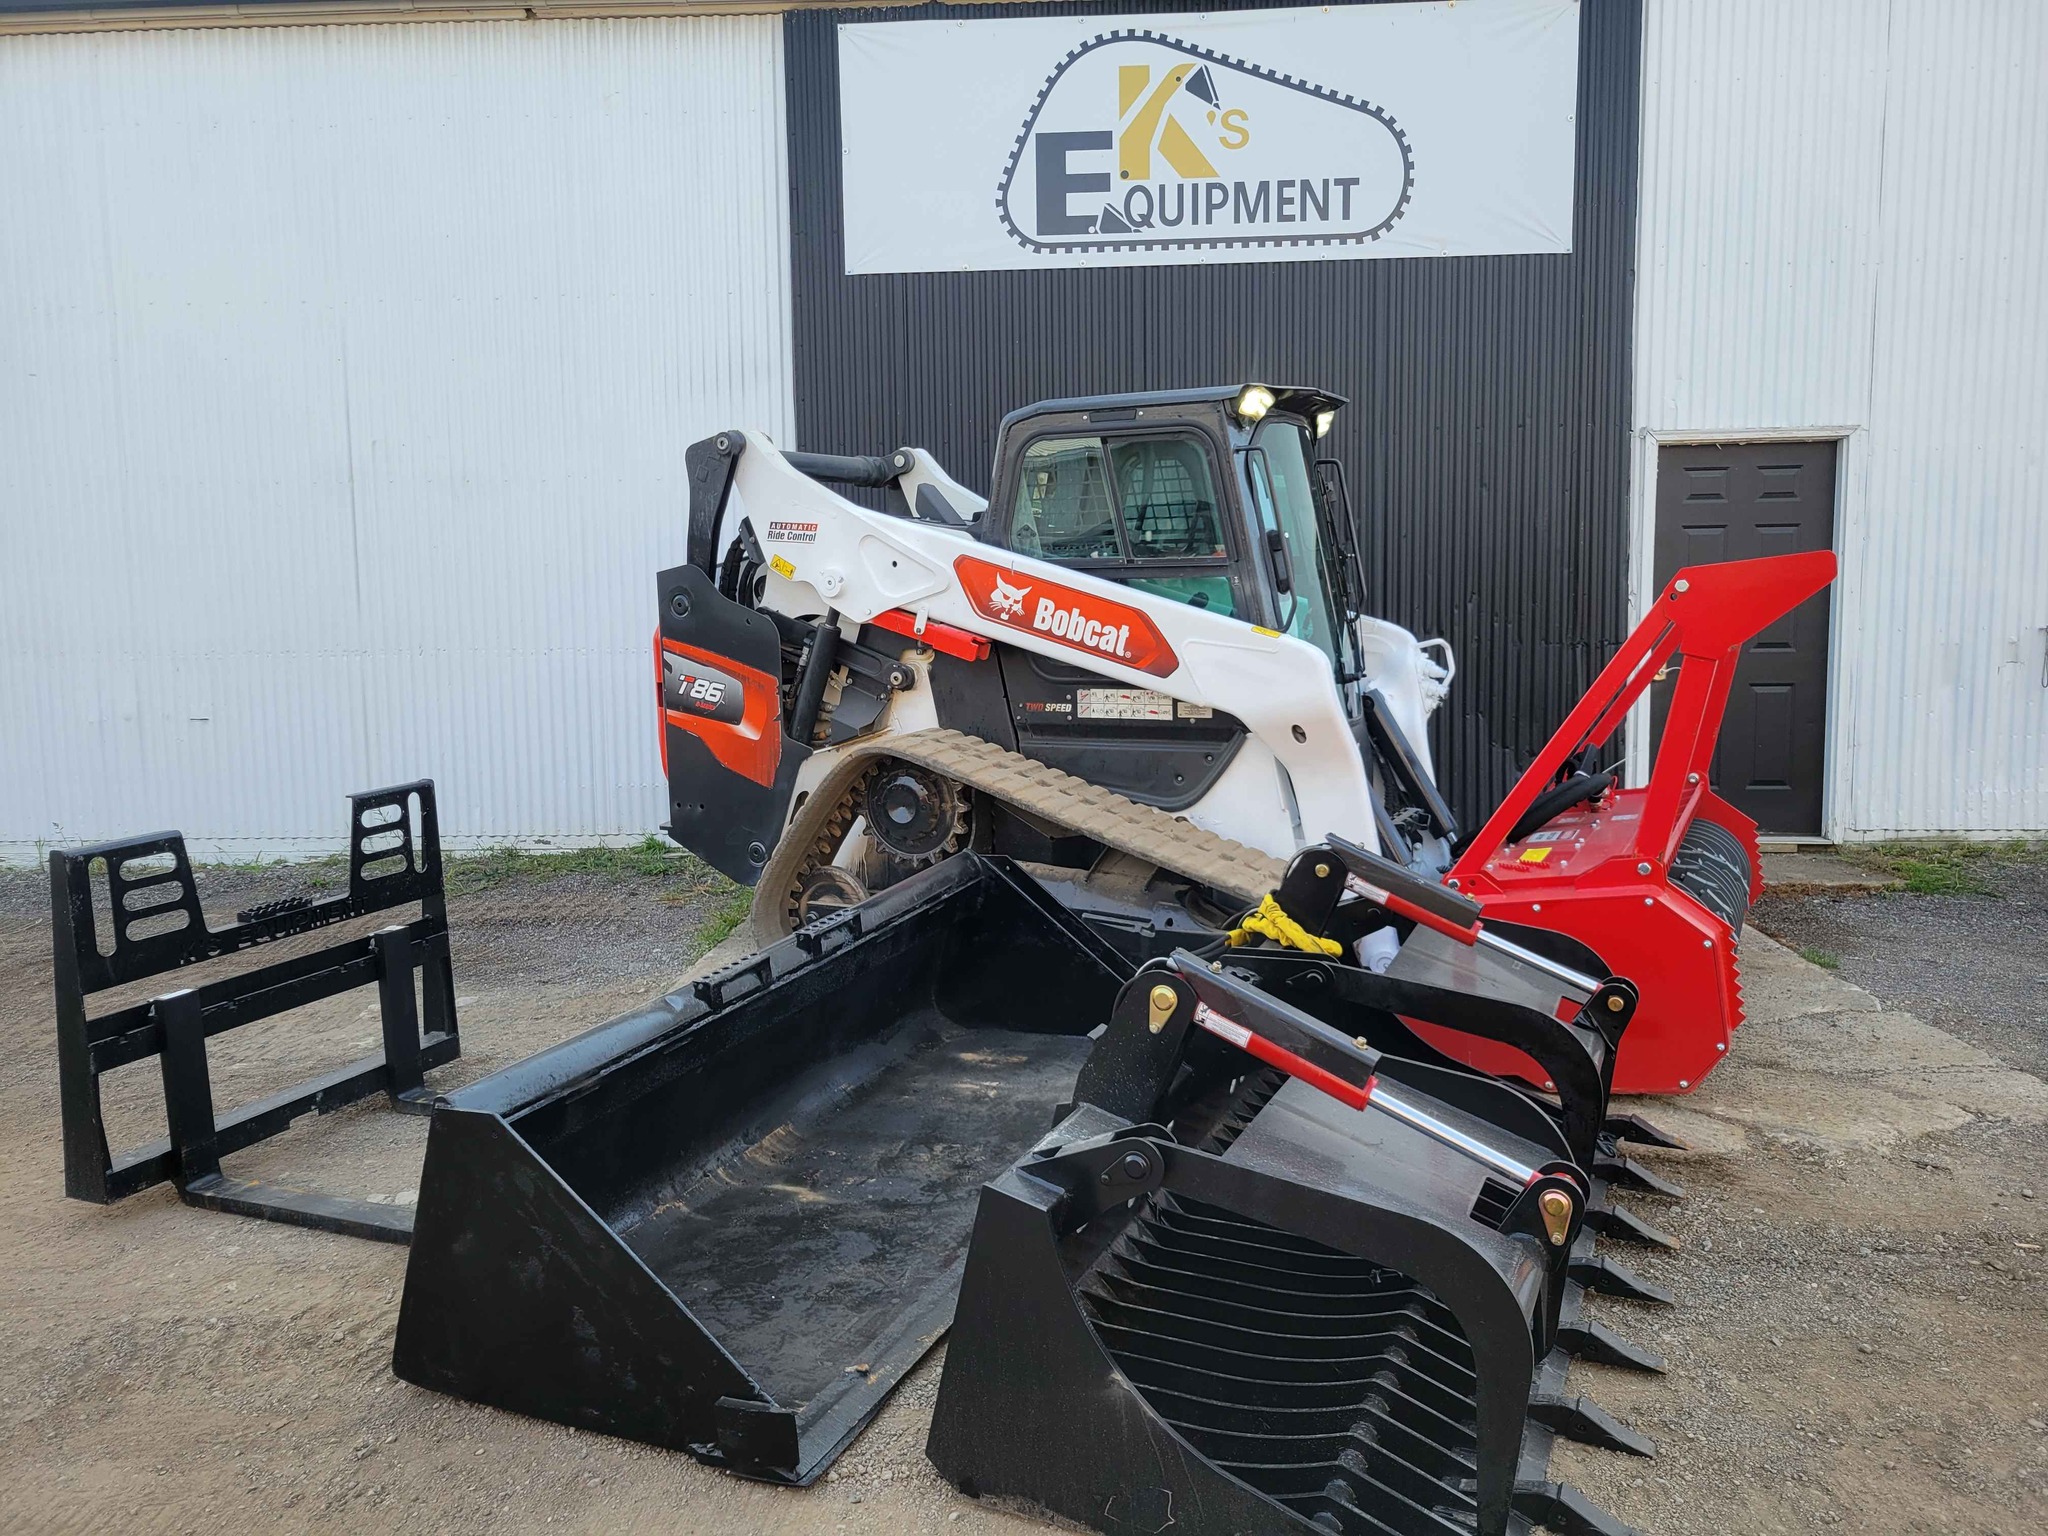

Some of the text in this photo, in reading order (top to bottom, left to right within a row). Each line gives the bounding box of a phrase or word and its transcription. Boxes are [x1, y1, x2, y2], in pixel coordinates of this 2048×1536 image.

[770, 522, 817, 531] AUTOMATIC
[767, 530, 817, 542] Ride Control
[1033, 596, 1130, 657] Bobcat
[678, 674, 726, 702] T86
[1025, 703, 1072, 713] TWO SPEED
